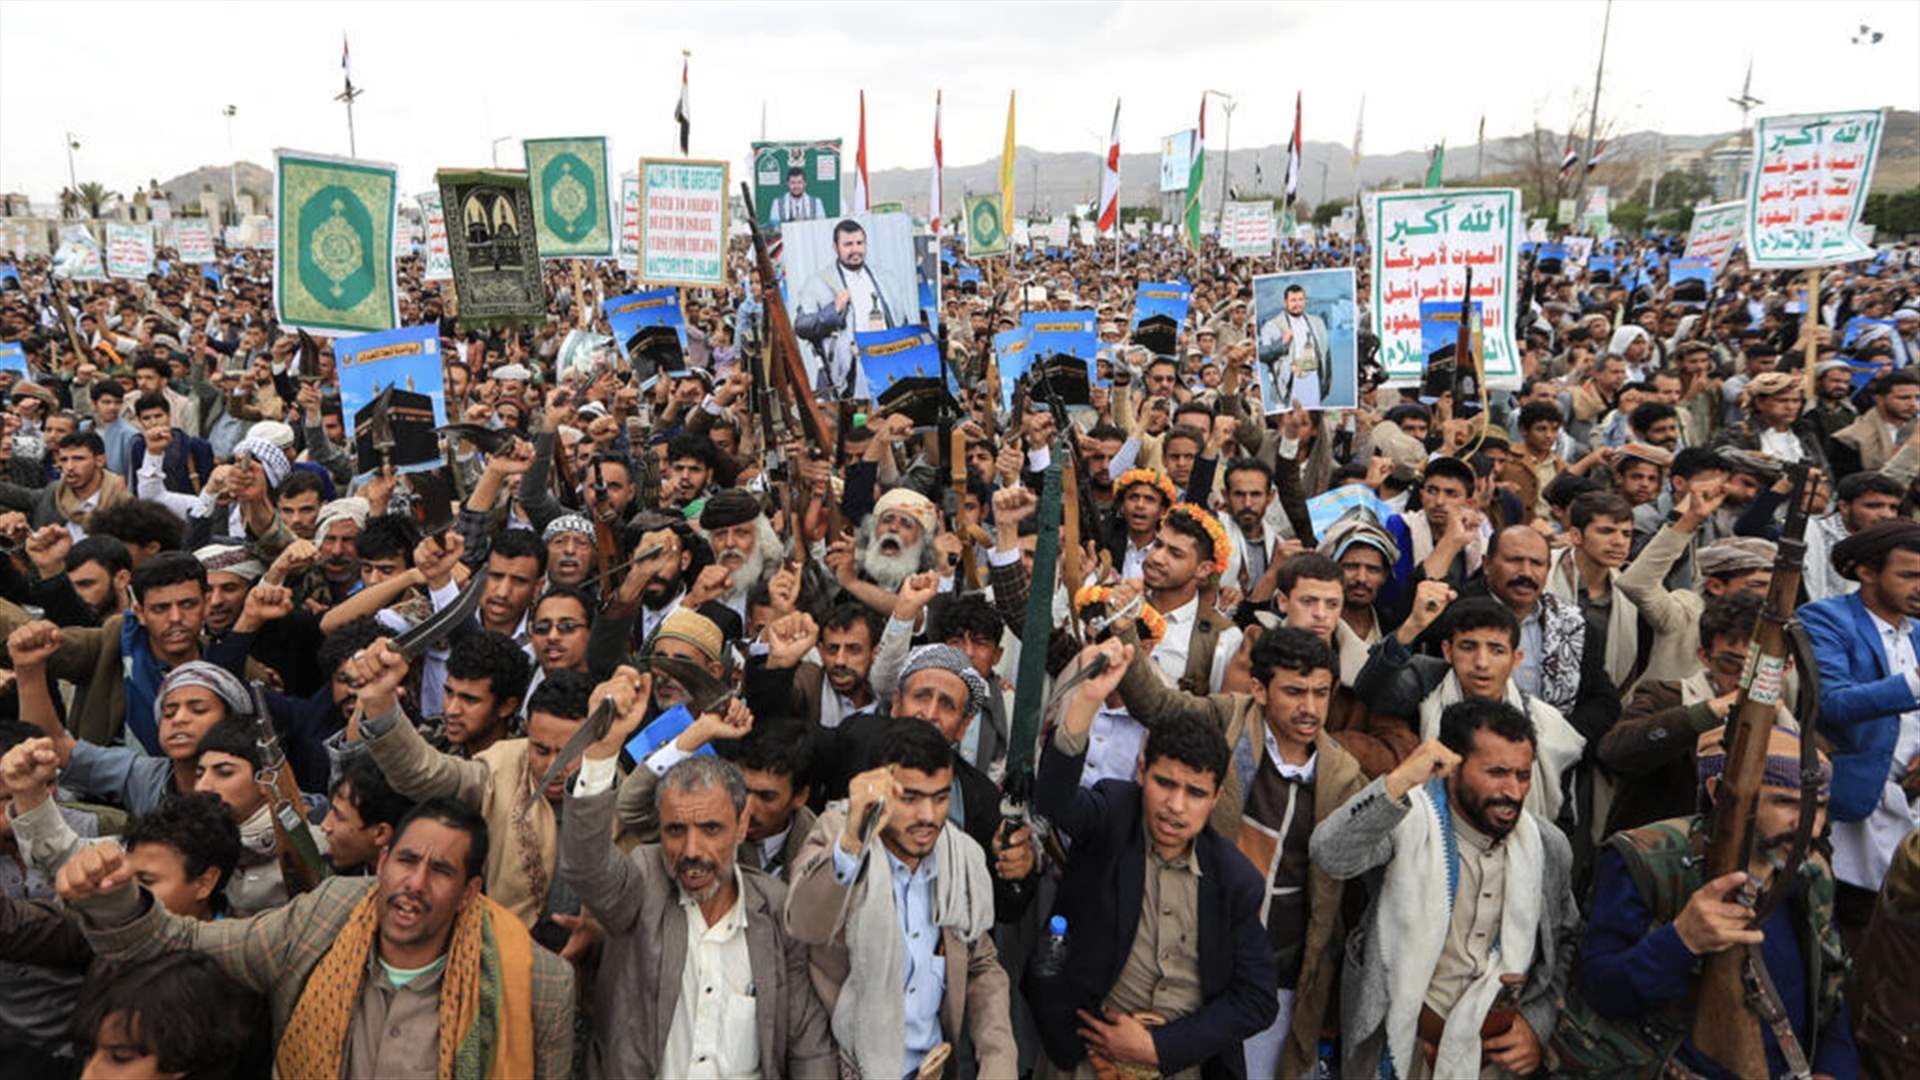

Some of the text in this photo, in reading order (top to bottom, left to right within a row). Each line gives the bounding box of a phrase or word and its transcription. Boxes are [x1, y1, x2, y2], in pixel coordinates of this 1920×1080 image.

[1385, 199, 1505, 246] الله أكبر
[1452, 244, 1504, 266] الموت
[1452, 276, 1502, 298] المت
